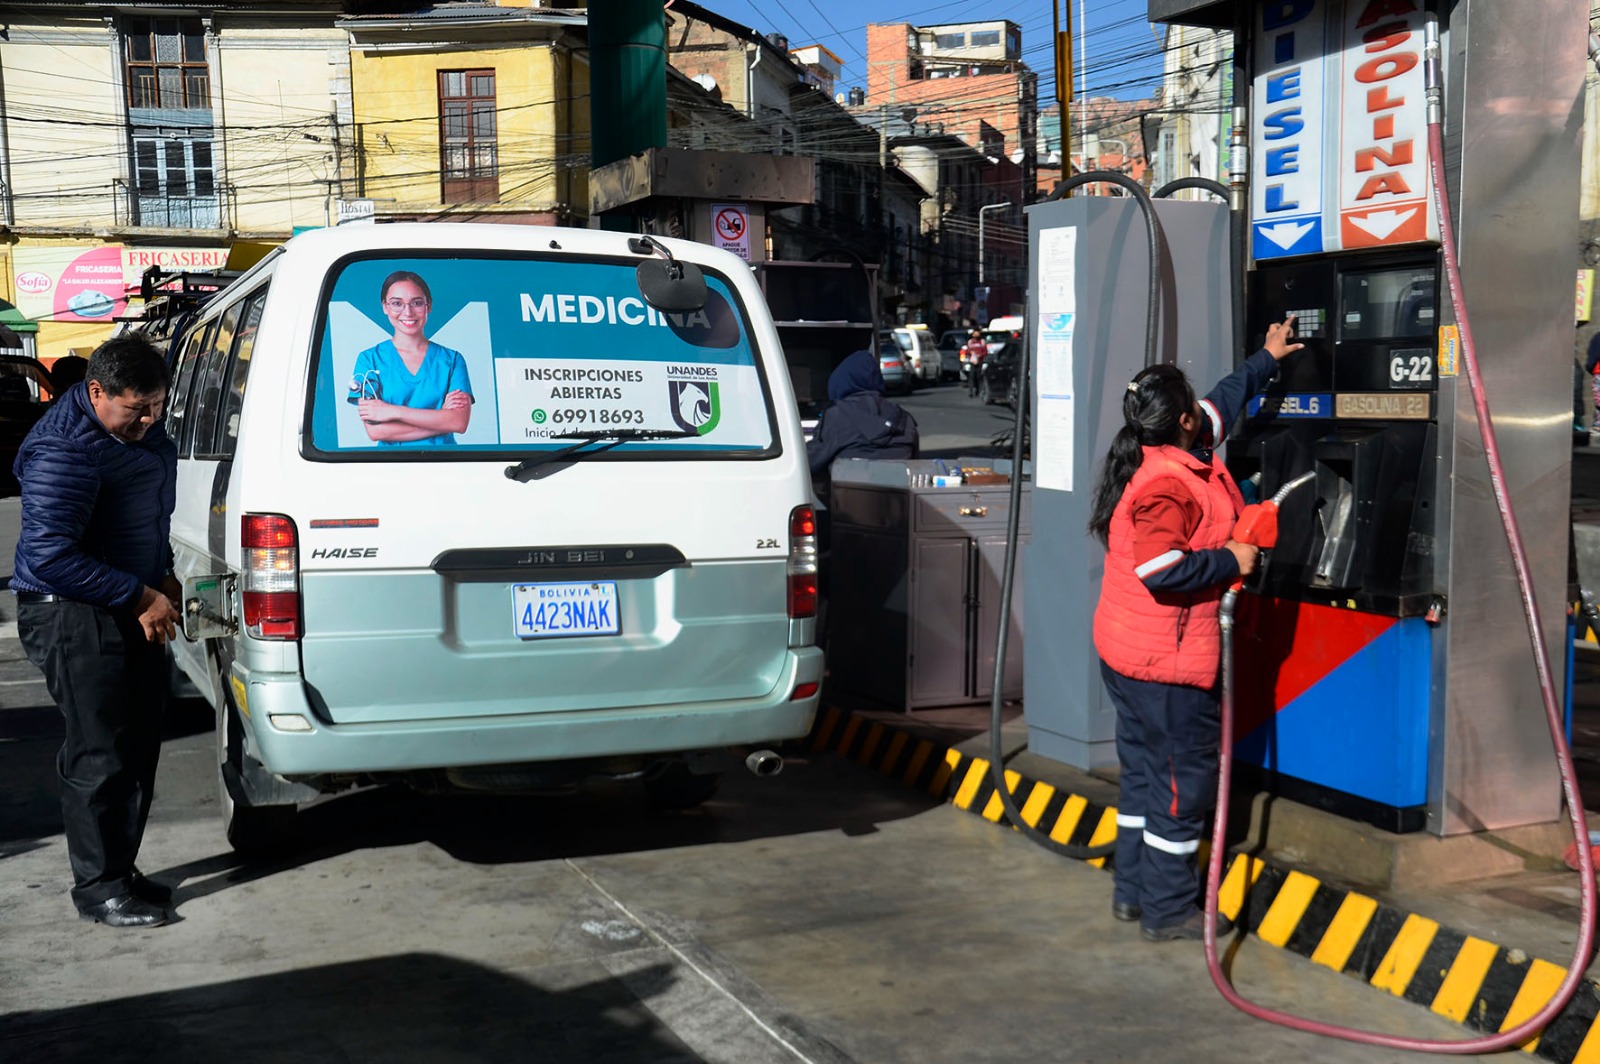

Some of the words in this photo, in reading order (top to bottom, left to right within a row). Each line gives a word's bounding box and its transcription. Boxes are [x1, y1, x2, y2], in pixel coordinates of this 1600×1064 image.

[1263, 0, 1315, 213] DIESEL
[128, 251, 229, 267] FRICASERIA
[75, 265, 122, 273] FRICASERIA
[520, 293, 712, 329] MEDICINA
[524, 368, 643, 383] INSCRIPCIONES
[666, 366, 718, 376] UNANDES
[1390, 356, 1432, 382] G-22
[550, 386, 622, 400] ABIERTAS
[552, 409, 644, 424] 69918693
[525, 427, 557, 438] Inicio
[311, 548, 379, 559] HAISE
[540, 588, 590, 598] BOLIVIA
[522, 600, 611, 631] 4423NAK
